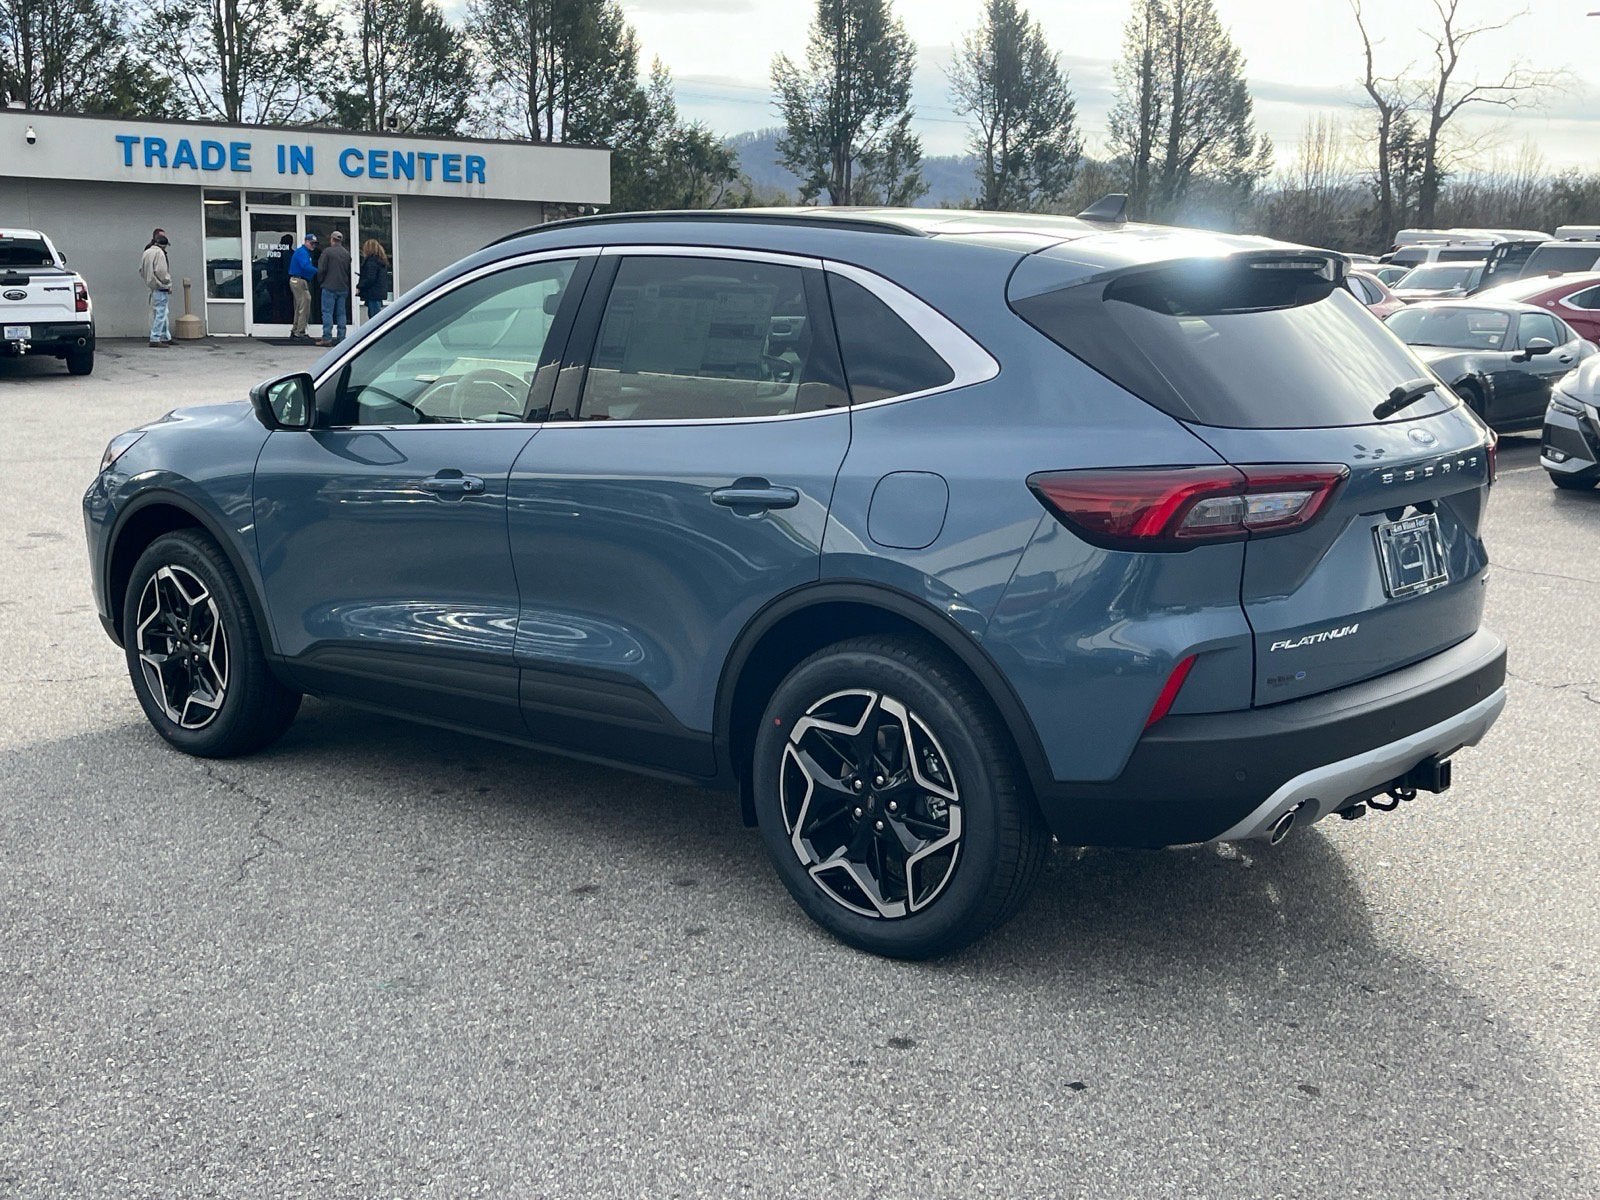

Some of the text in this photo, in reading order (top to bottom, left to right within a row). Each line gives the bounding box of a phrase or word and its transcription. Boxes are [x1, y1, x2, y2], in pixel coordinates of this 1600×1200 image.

[115, 135, 487, 184] TRADE IN CENTER
[1381, 456, 1477, 484] ESCAPE
[1270, 623, 1360, 652] PLATINUM
